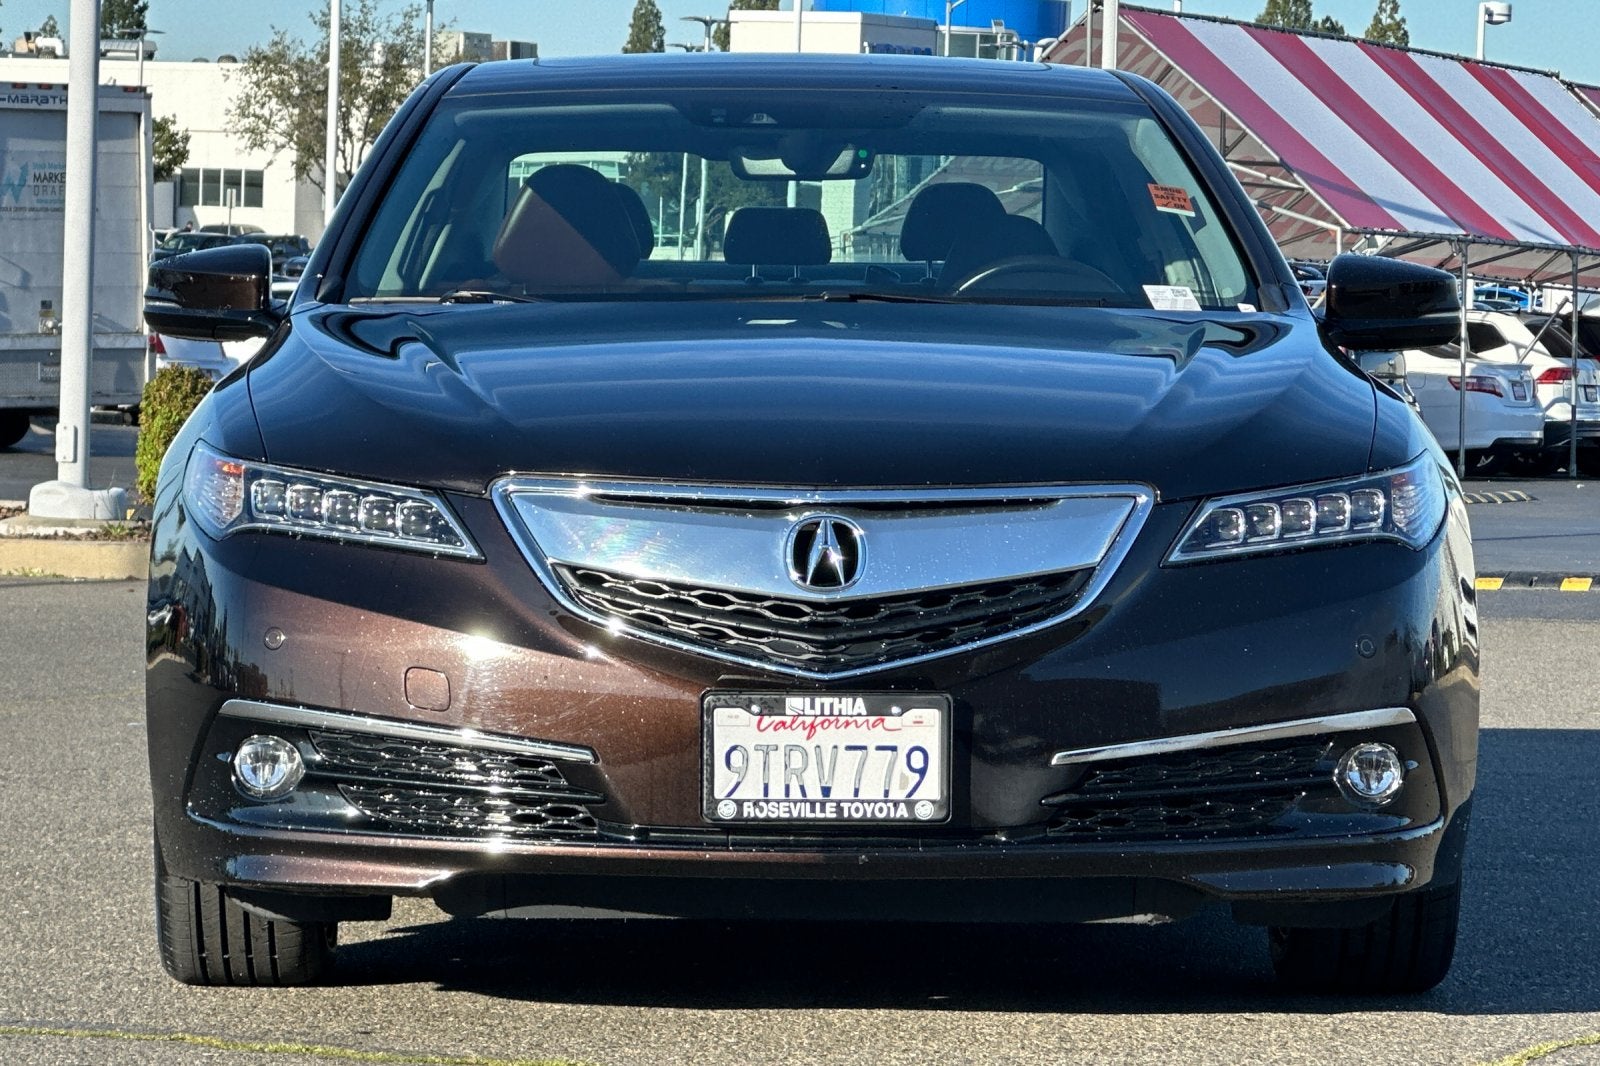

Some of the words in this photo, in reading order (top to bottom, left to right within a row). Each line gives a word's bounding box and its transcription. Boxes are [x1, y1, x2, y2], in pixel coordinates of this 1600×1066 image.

[1154, 193, 1187, 203] SAFETY
[804, 697, 867, 716] LITHIA
[756, 715, 902, 740] California
[725, 744, 930, 799] 9TRV779
[743, 802, 836, 818] ROSEVILLE
[840, 802, 909, 819] TOYOTA
